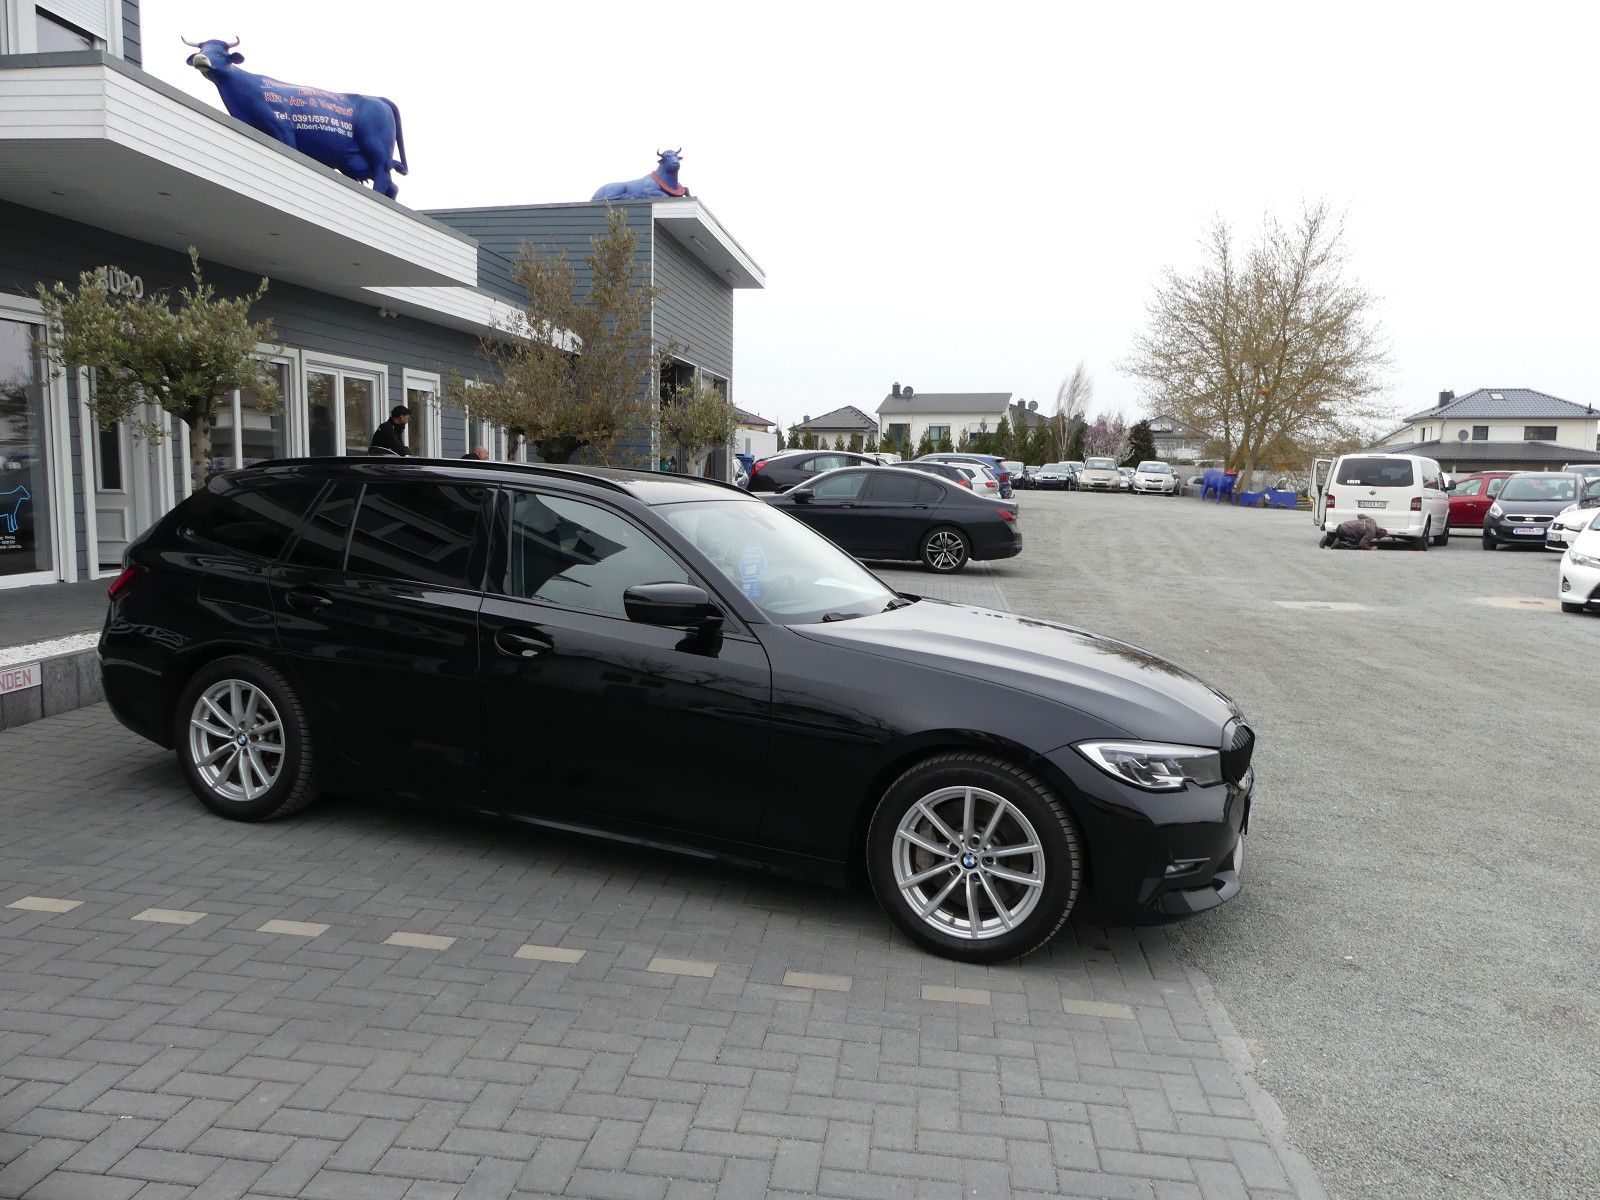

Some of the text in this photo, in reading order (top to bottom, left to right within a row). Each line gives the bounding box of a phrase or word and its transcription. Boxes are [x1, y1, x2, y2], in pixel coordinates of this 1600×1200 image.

[274, 111, 290, 119] Tel.
[292, 114, 329, 123] 0391/597
[341, 122, 352, 131] 100
